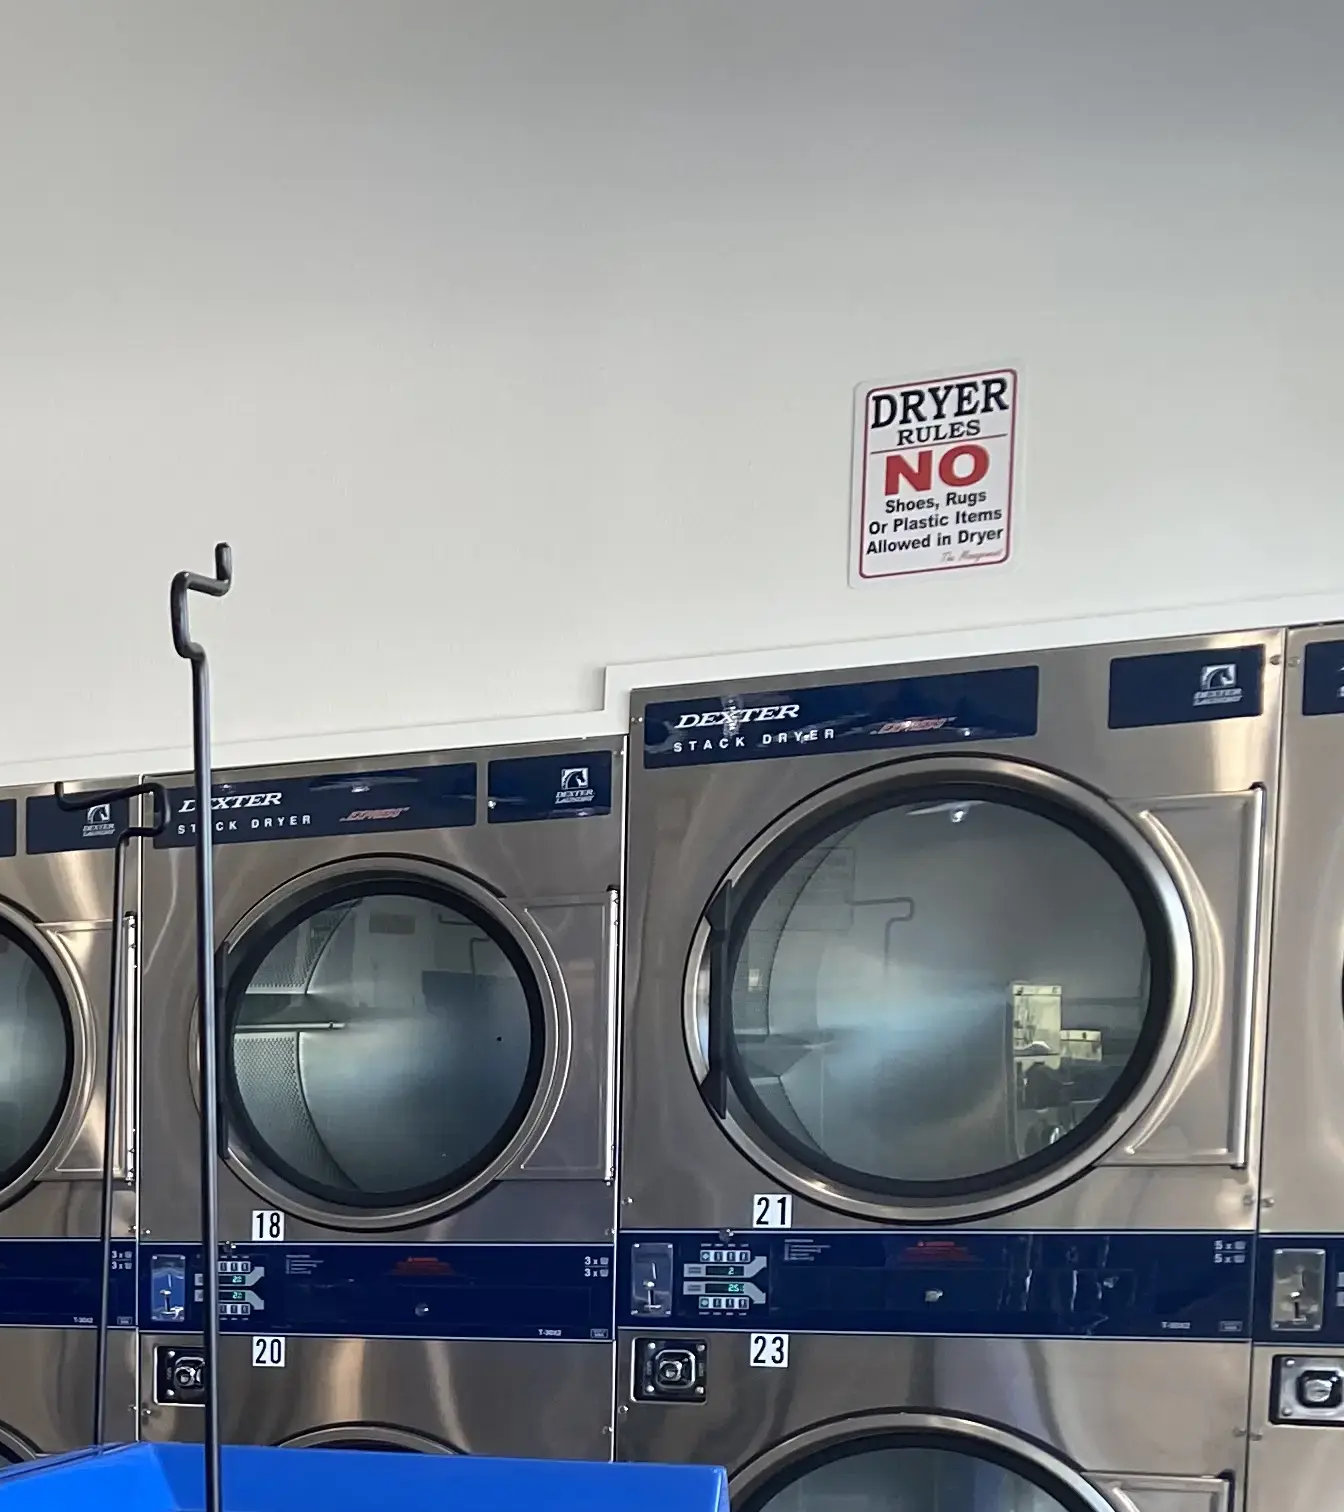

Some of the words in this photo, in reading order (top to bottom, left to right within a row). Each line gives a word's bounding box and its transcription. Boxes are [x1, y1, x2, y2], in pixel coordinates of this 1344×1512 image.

[871, 377, 1009, 429] DRYER
[897, 419, 981, 446] RULES
[885, 444, 990, 496] NO
[885, 496, 940, 514] Shoes,
[946, 491, 987, 508] Rugs
[869, 520, 888, 534] Or
[893, 513, 949, 533] Plastic
[956, 509, 1002, 525] Items
[866, 534, 931, 555] Allowed
[937, 532, 951, 546] in
[958, 527, 1004, 547] Dryer
[674, 704, 800, 729] DEXTER
[673, 736, 746, 752] STACK
[762, 728, 835, 745] DRYER
[178, 792, 282, 813] DXTER
[251, 814, 311, 829] DRYER
[756, 1197, 787, 1226] 21
[256, 1213, 281, 1238] 18
[256, 1339, 282, 1364] 20
[753, 1335, 784, 1364] 23
